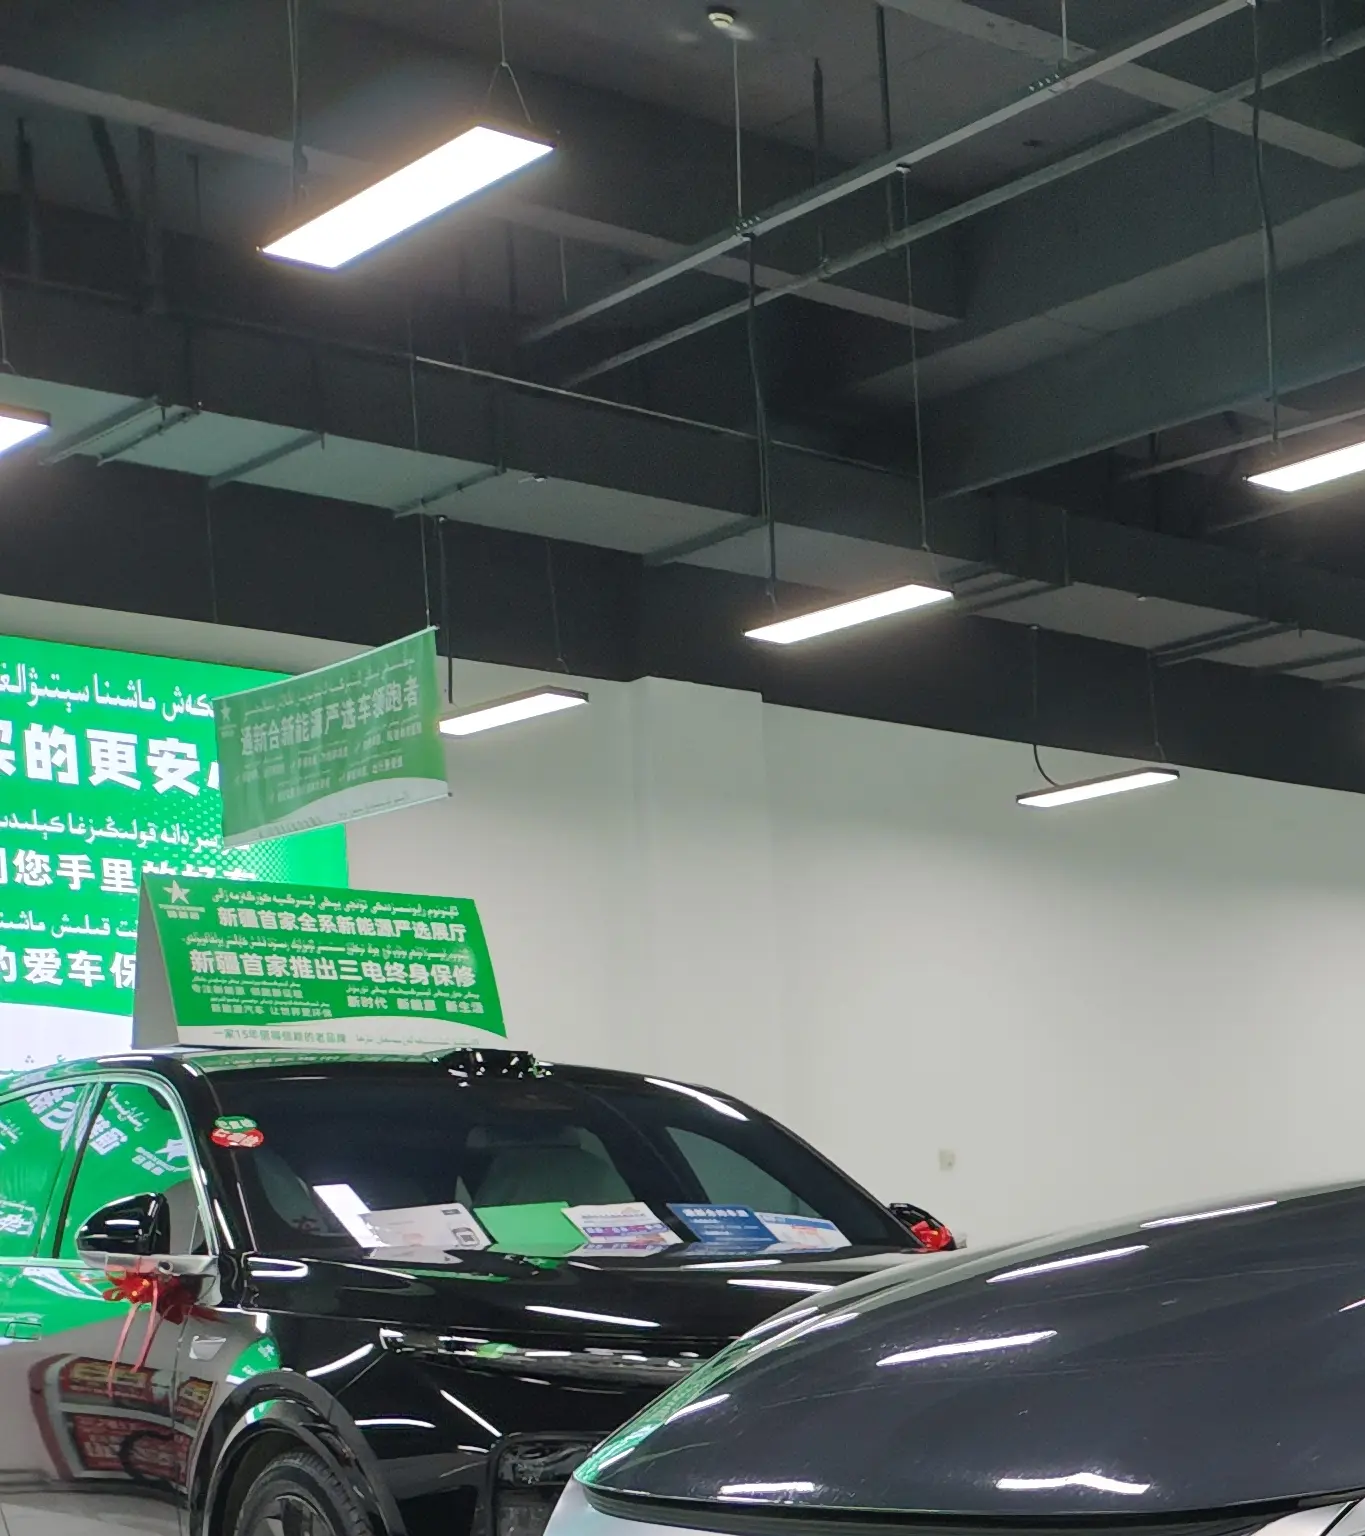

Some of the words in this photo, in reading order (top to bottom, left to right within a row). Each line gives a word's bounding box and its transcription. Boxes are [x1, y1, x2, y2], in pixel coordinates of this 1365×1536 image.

[217, 906, 466, 942] 新疆首家全系新能源严选展厅
[190, 949, 476, 988] 新疆首家推出三电终身保修
